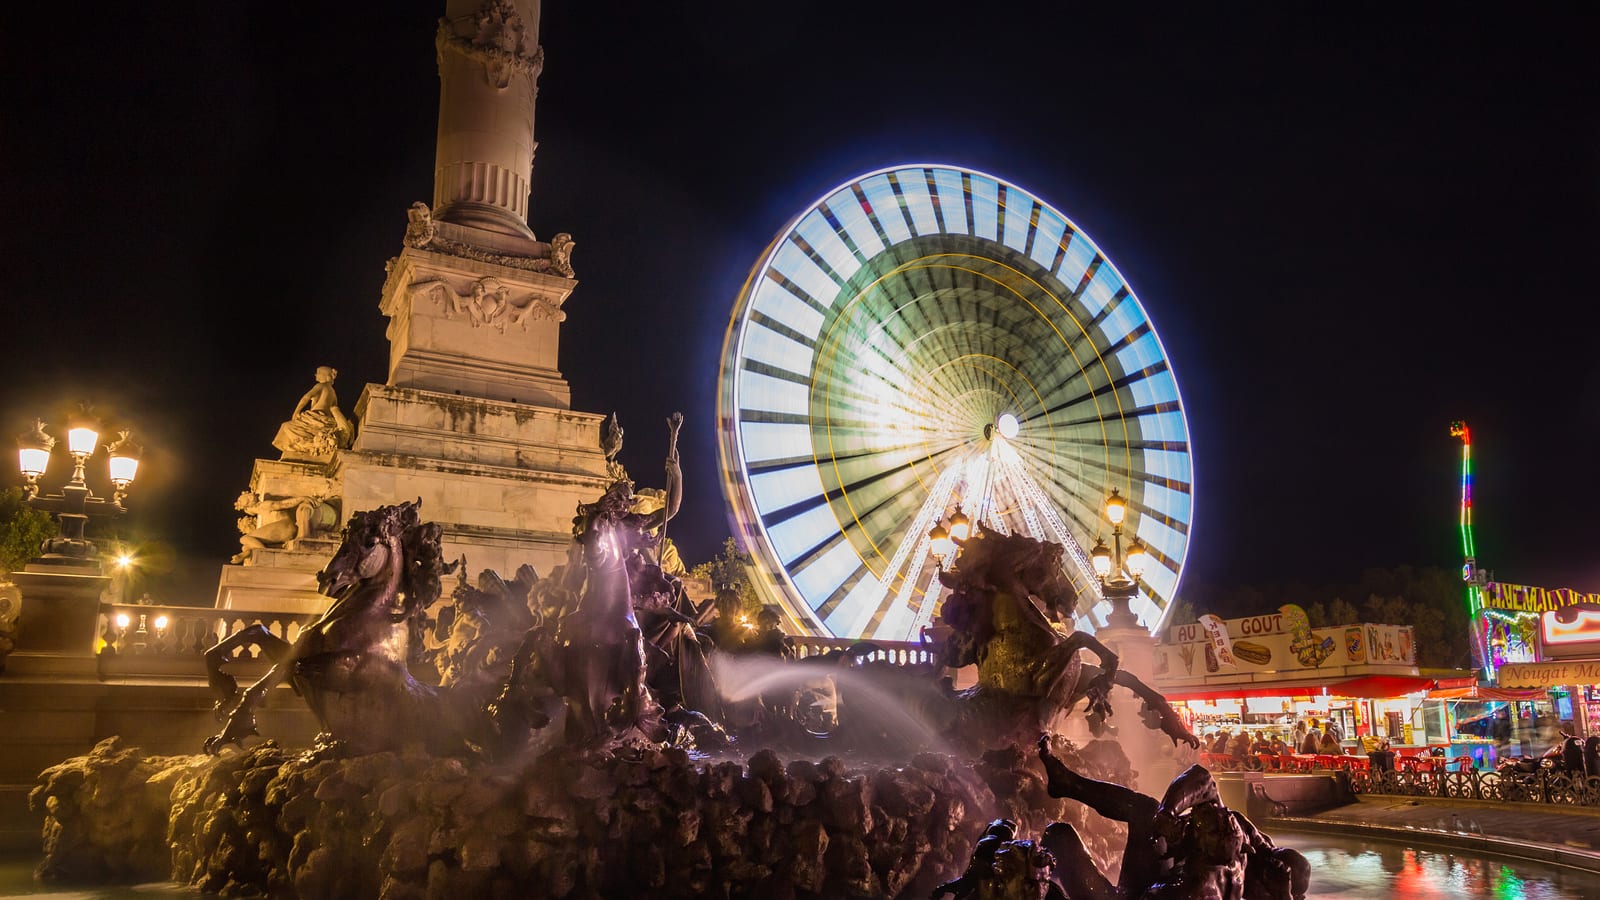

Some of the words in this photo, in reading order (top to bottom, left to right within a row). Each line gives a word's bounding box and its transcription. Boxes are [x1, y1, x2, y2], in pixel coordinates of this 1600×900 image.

[1179, 625, 1196, 641] AU
[1241, 615, 1282, 635] GOUT
[1507, 666, 1568, 684] Nougat
